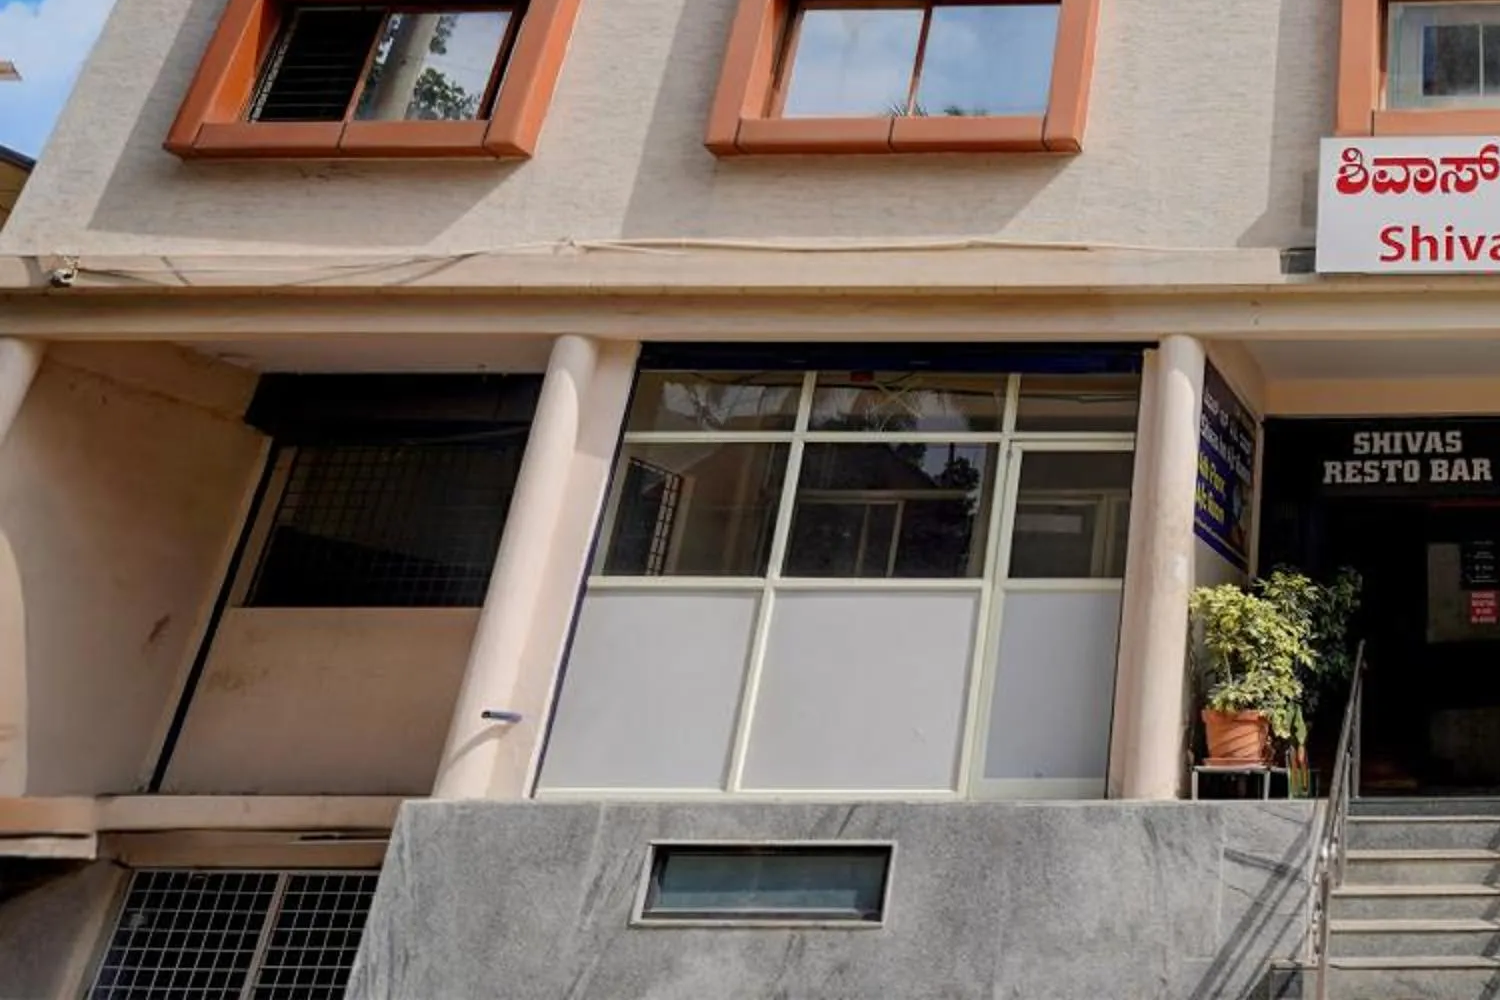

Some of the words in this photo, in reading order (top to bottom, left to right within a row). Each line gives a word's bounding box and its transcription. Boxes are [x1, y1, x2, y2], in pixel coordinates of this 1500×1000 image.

[1335, 144, 1500, 195] ಶಿವಾಸ್
[1354, 431, 1463, 454] SHIVAS
[1323, 459, 1421, 483] RESTO
[1429, 457, 1493, 482] BAR
